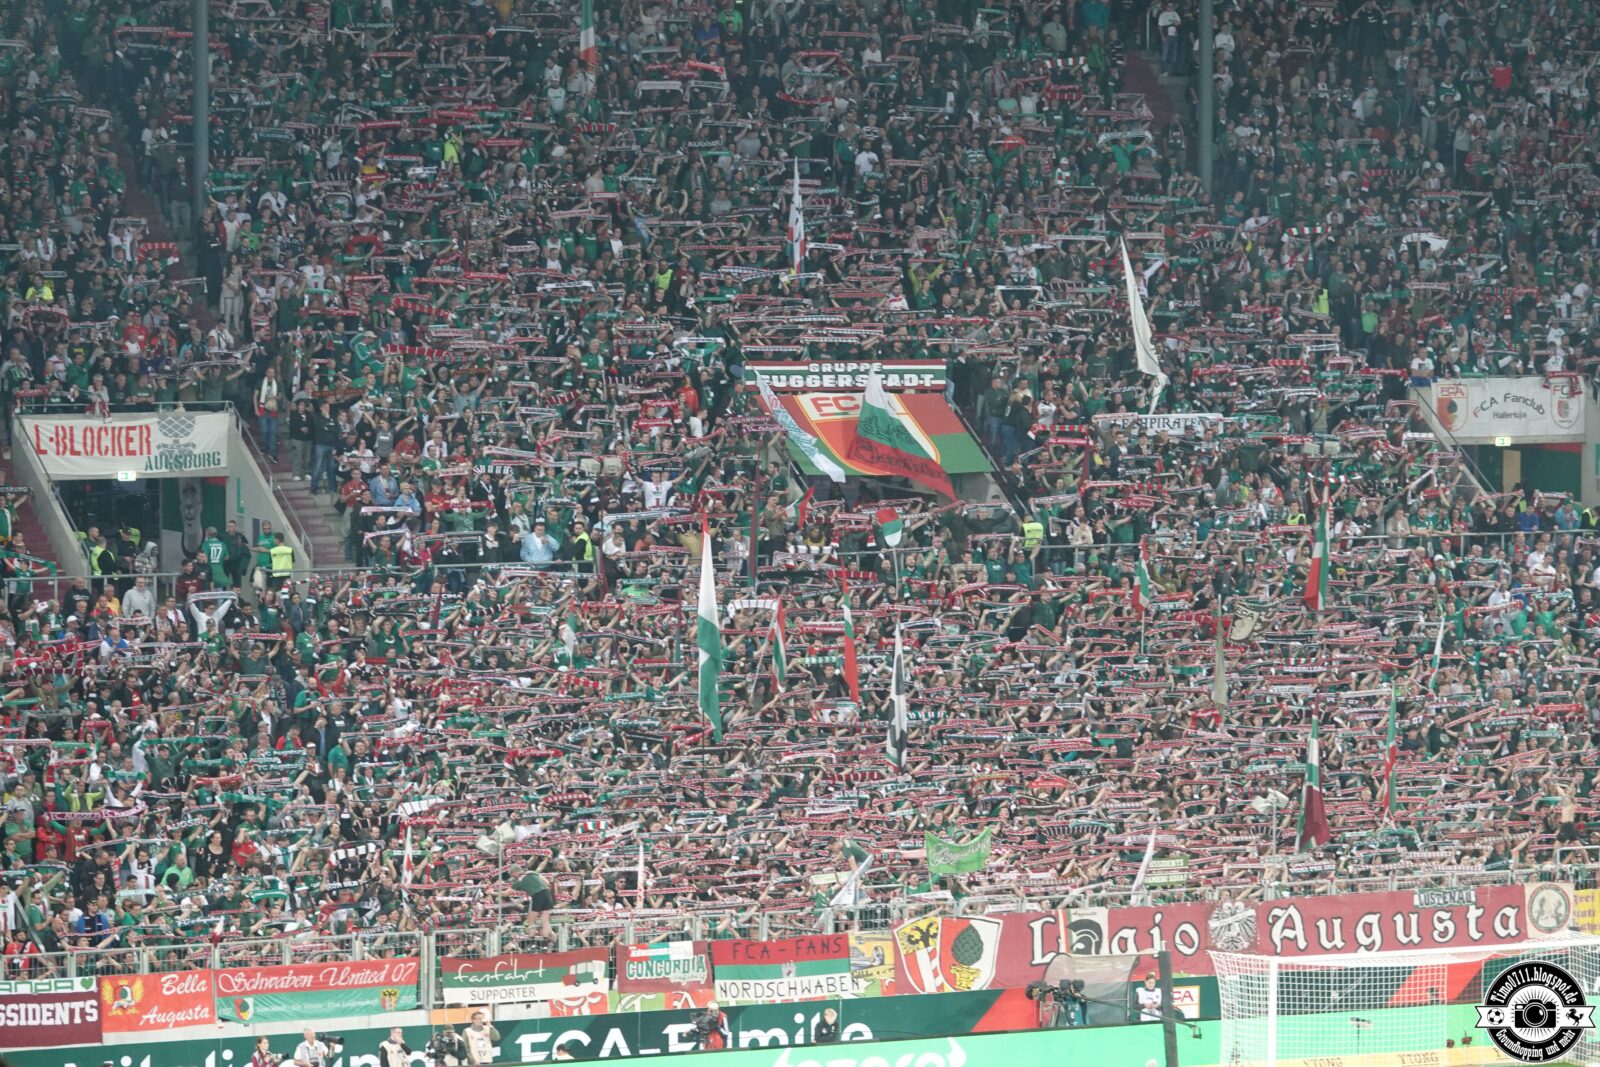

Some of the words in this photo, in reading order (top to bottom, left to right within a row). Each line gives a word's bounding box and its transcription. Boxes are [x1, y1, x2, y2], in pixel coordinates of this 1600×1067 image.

[809, 363, 883, 373] GRUPPE
[1441, 386, 1465, 397] FCA
[1552, 384, 1570, 396] FC
[809, 395, 861, 413] FC
[1473, 396, 1499, 418] FCA
[1503, 393, 1546, 416] Fanclub
[34, 424, 152, 456] L-BLOCKER
[144, 450, 221, 471] AUGSBURG
[1418, 889, 1472, 906] LUSTENAU
[1028, 911, 1200, 967] Lgio
[1267, 903, 1522, 954] Augusta
[732, 942, 770, 960] FCA
[795, 936, 843, 957] FANS
[218, 971, 314, 993] Schwaben
[319, 963, 390, 987] United
[391, 962, 416, 983] 07
[626, 955, 707, 979] CONCORDIA
[160, 974, 208, 996] Bella
[470, 986, 536, 1001] SUPPORTER
[719, 975, 860, 999] NORDSCHWABEN
[139, 1004, 210, 1028] Augusta
[1397, 1052, 1440, 1065] YTONG
